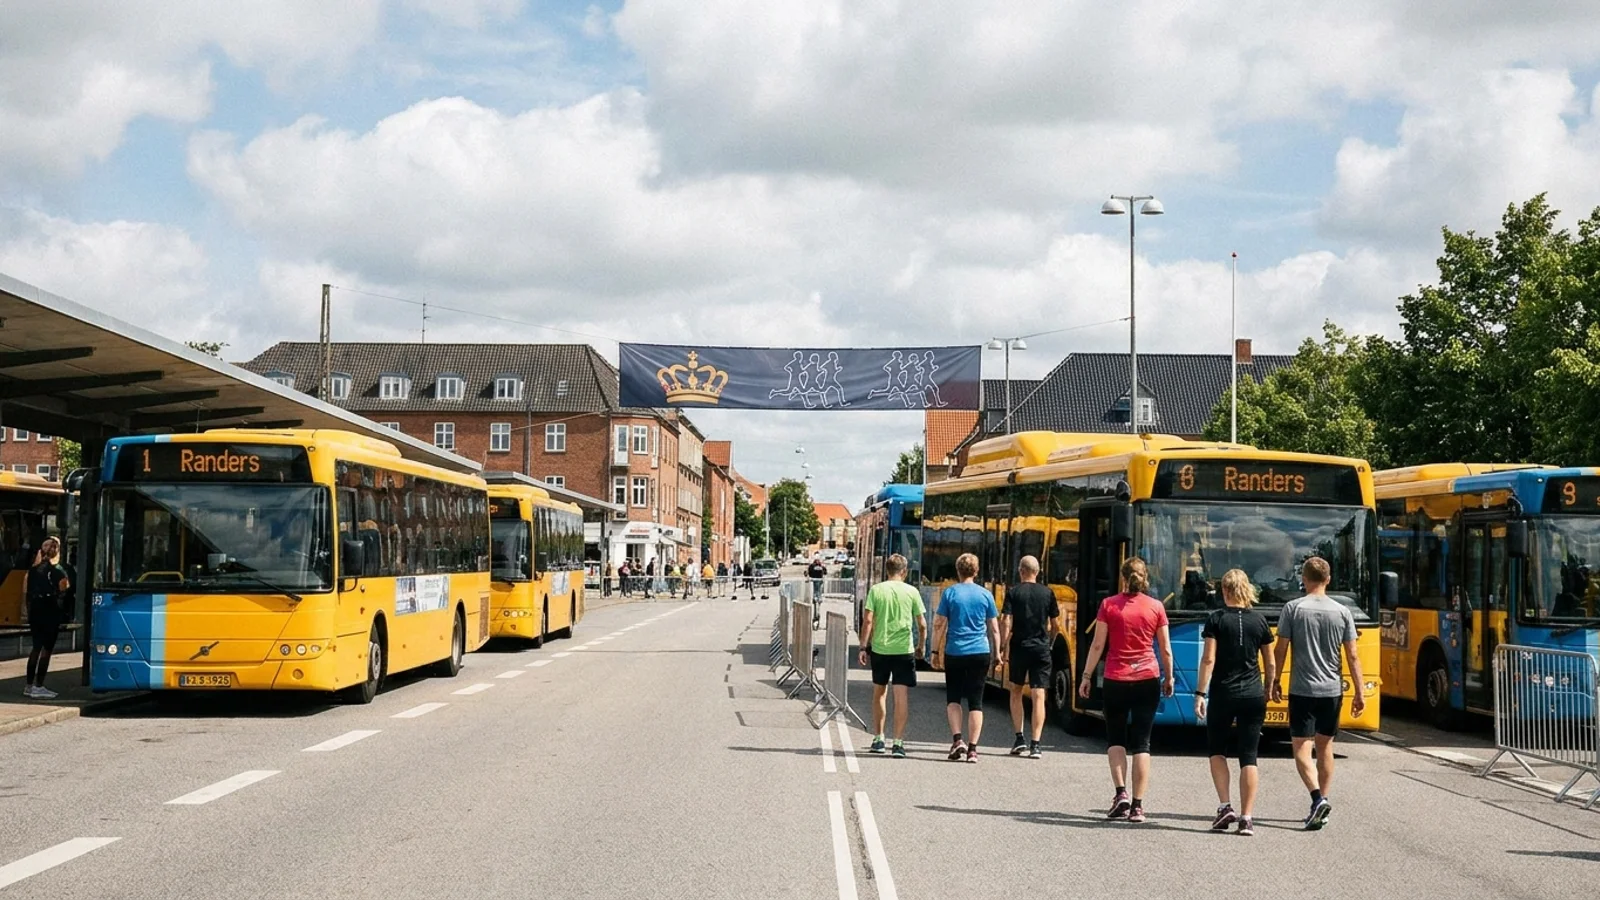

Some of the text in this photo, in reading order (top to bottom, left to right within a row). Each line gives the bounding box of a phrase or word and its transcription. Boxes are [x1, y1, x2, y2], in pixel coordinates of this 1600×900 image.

[143, 449, 260, 473] 1 Randers
[1224, 466, 1305, 493] Randers
[1563, 481, 1576, 505] 9
